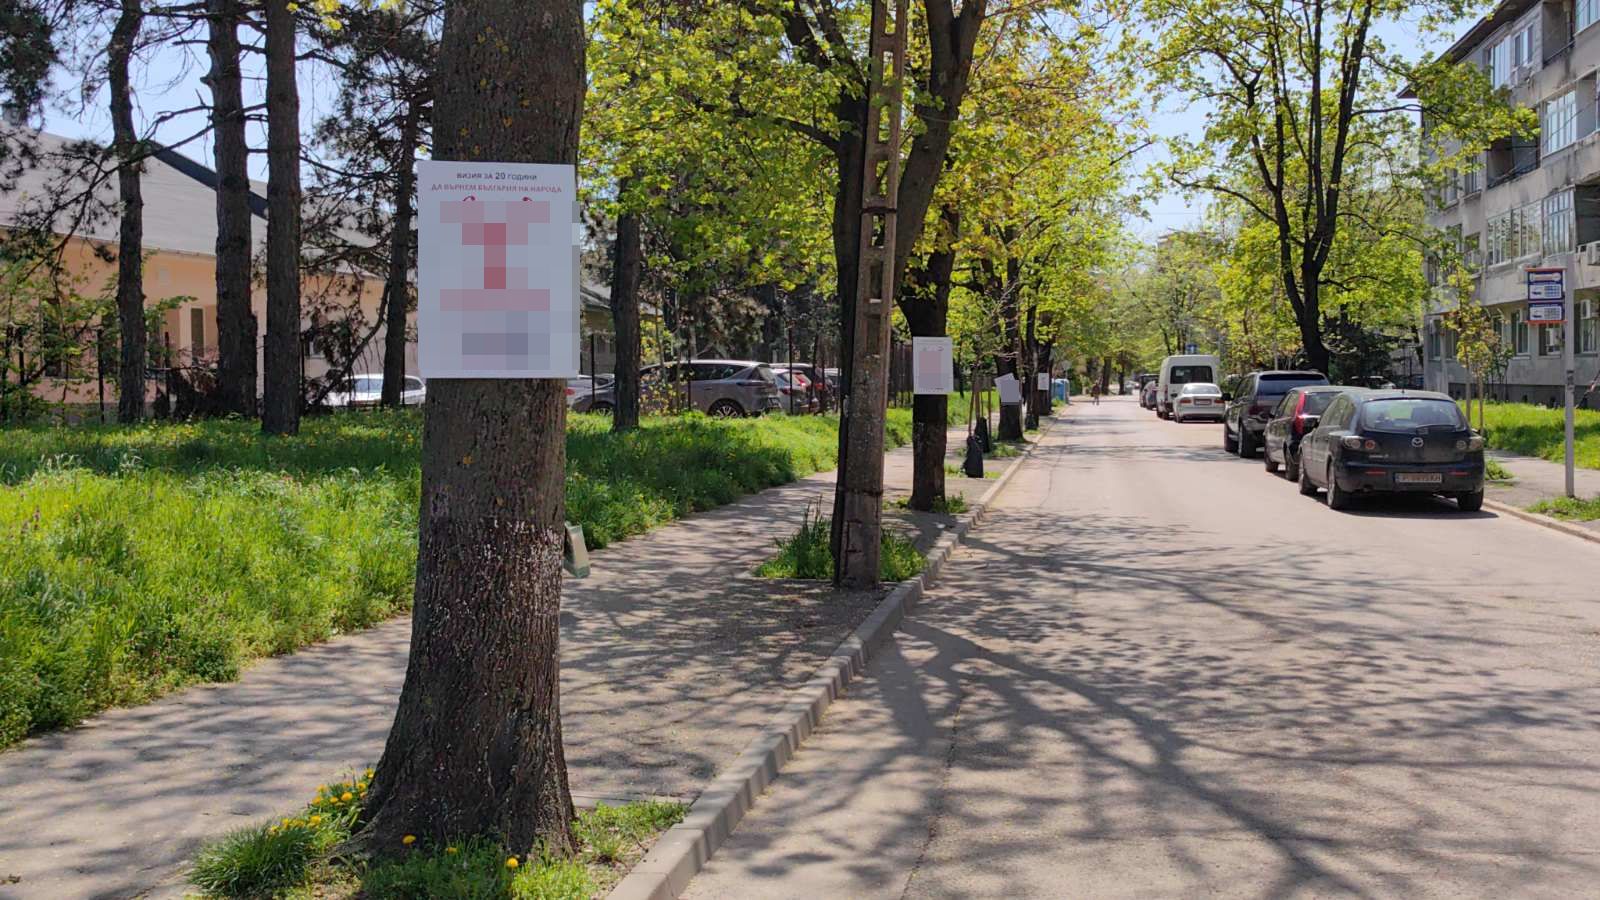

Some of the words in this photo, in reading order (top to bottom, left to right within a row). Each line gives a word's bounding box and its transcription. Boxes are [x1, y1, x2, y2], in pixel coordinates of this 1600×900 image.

[495, 171, 506, 180] 20
[431, 183, 443, 192] ДА
[443, 183, 477, 192] ВЪРНЕМ
[478, 184, 517, 193] БЪЛГАРИЯ
[518, 185, 529, 193] НА
[530, 185, 563, 194] НАРОДА
